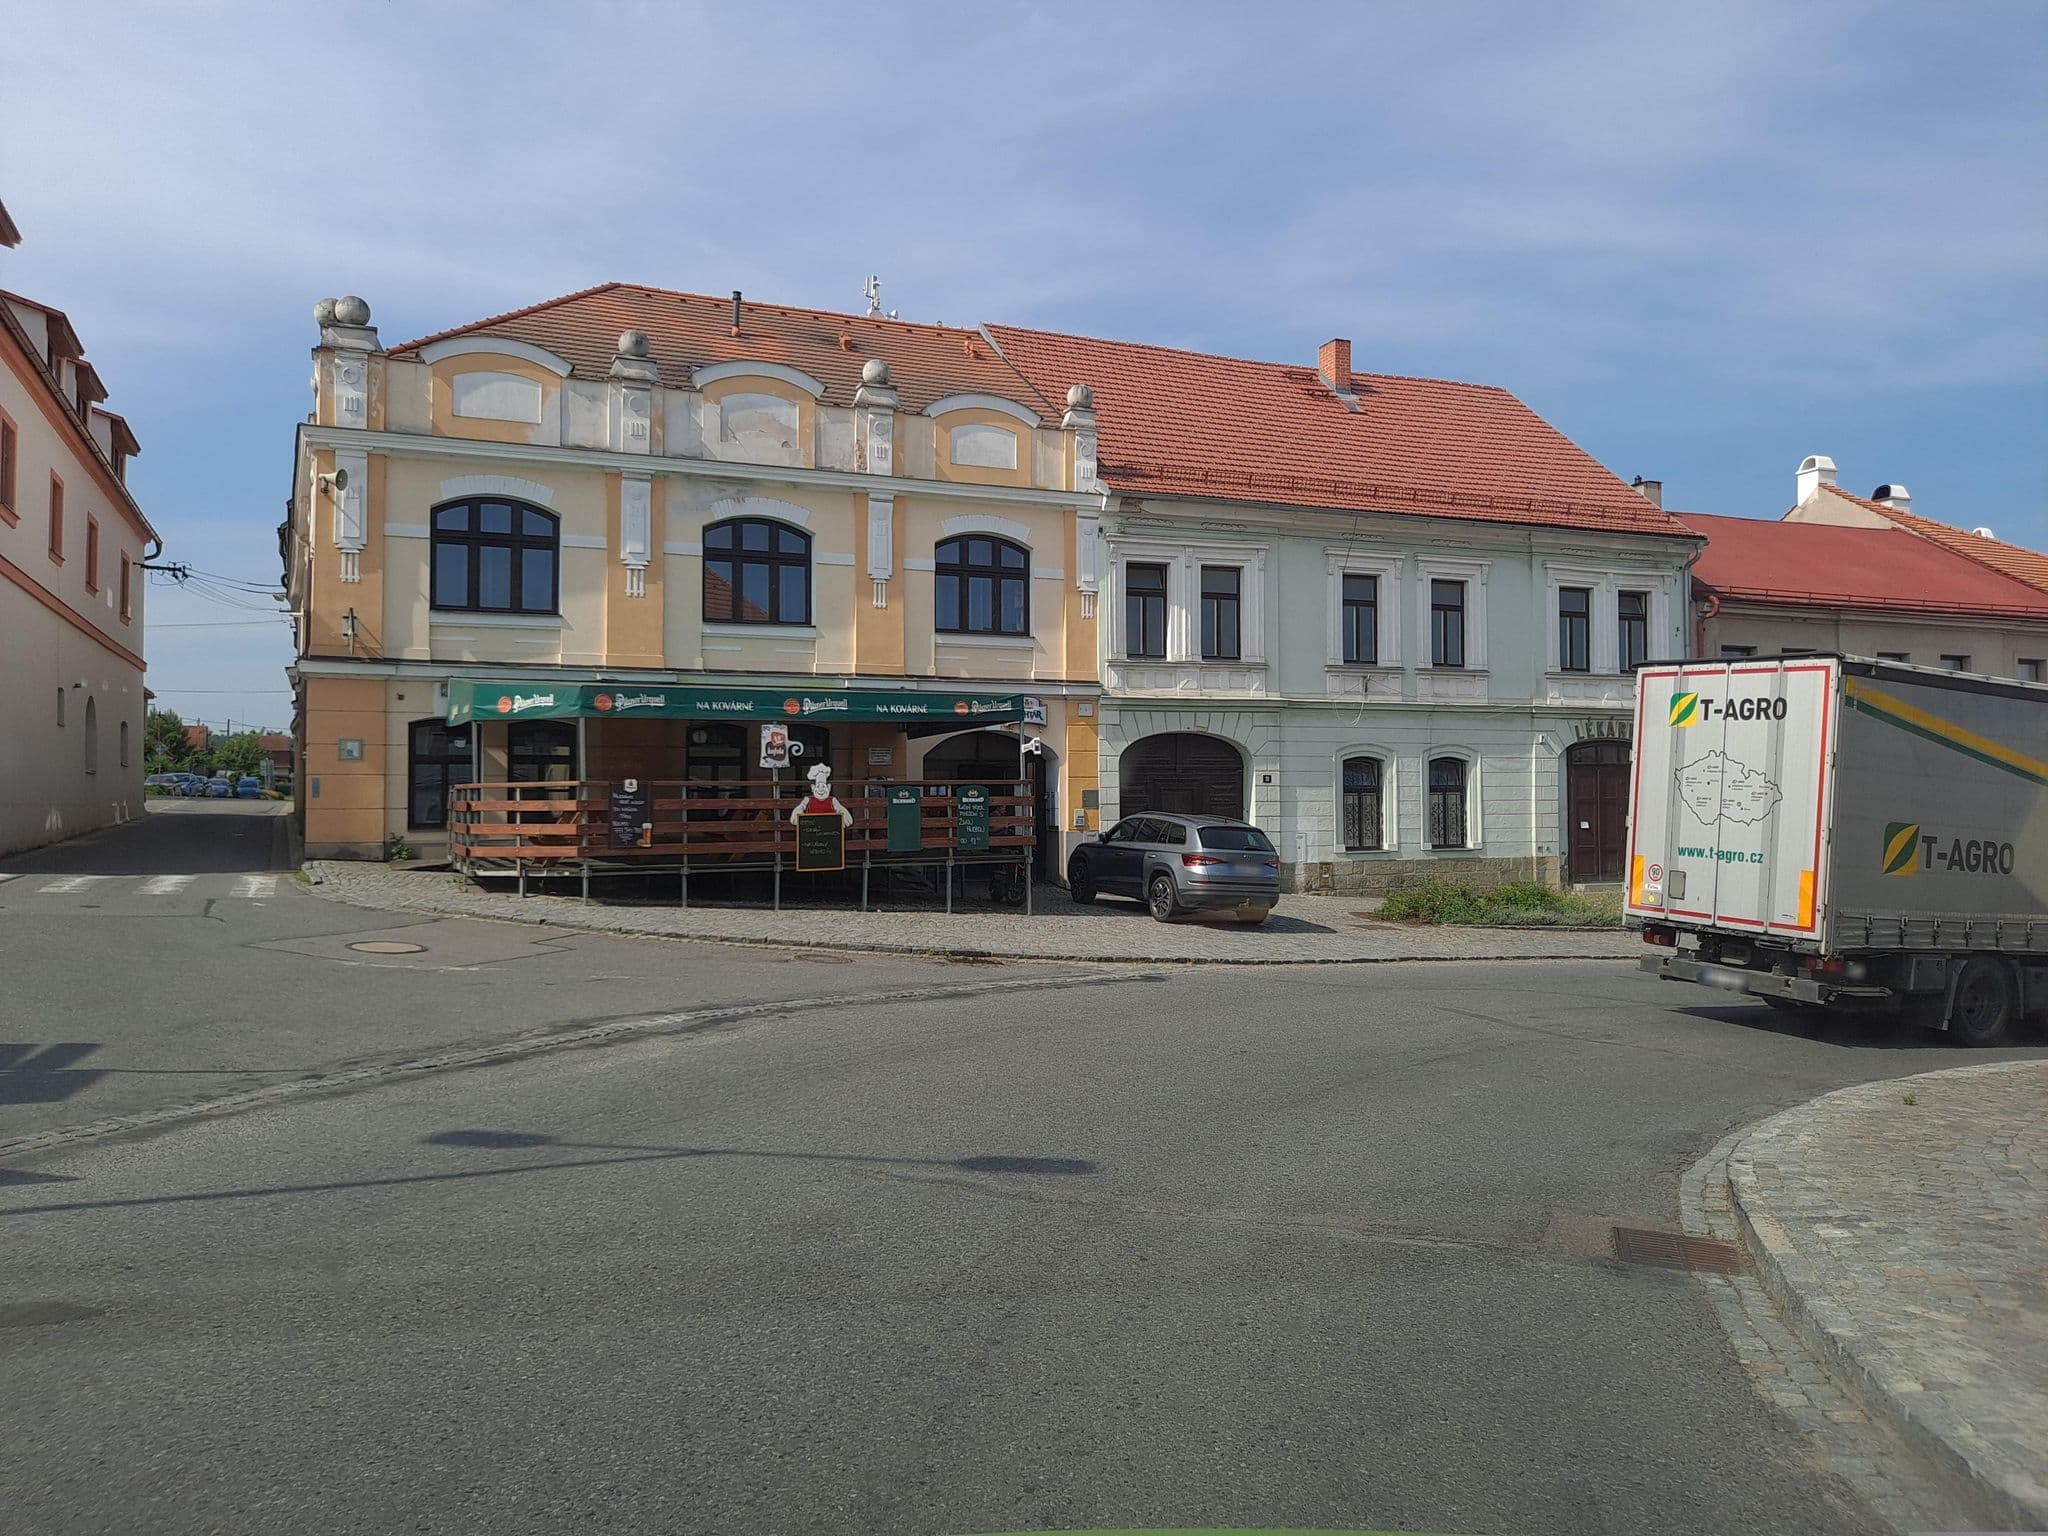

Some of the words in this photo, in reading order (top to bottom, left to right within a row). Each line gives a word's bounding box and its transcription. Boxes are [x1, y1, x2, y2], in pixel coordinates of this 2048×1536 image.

[696, 701, 710, 711] NA
[876, 704, 889, 713] NA
[1700, 697, 1788, 721] T-AGRO
[1678, 846, 1764, 864] www.t-agro.cz
[1921, 835, 2015, 875] T-AGRO
[1651, 867, 1661, 877] 90
